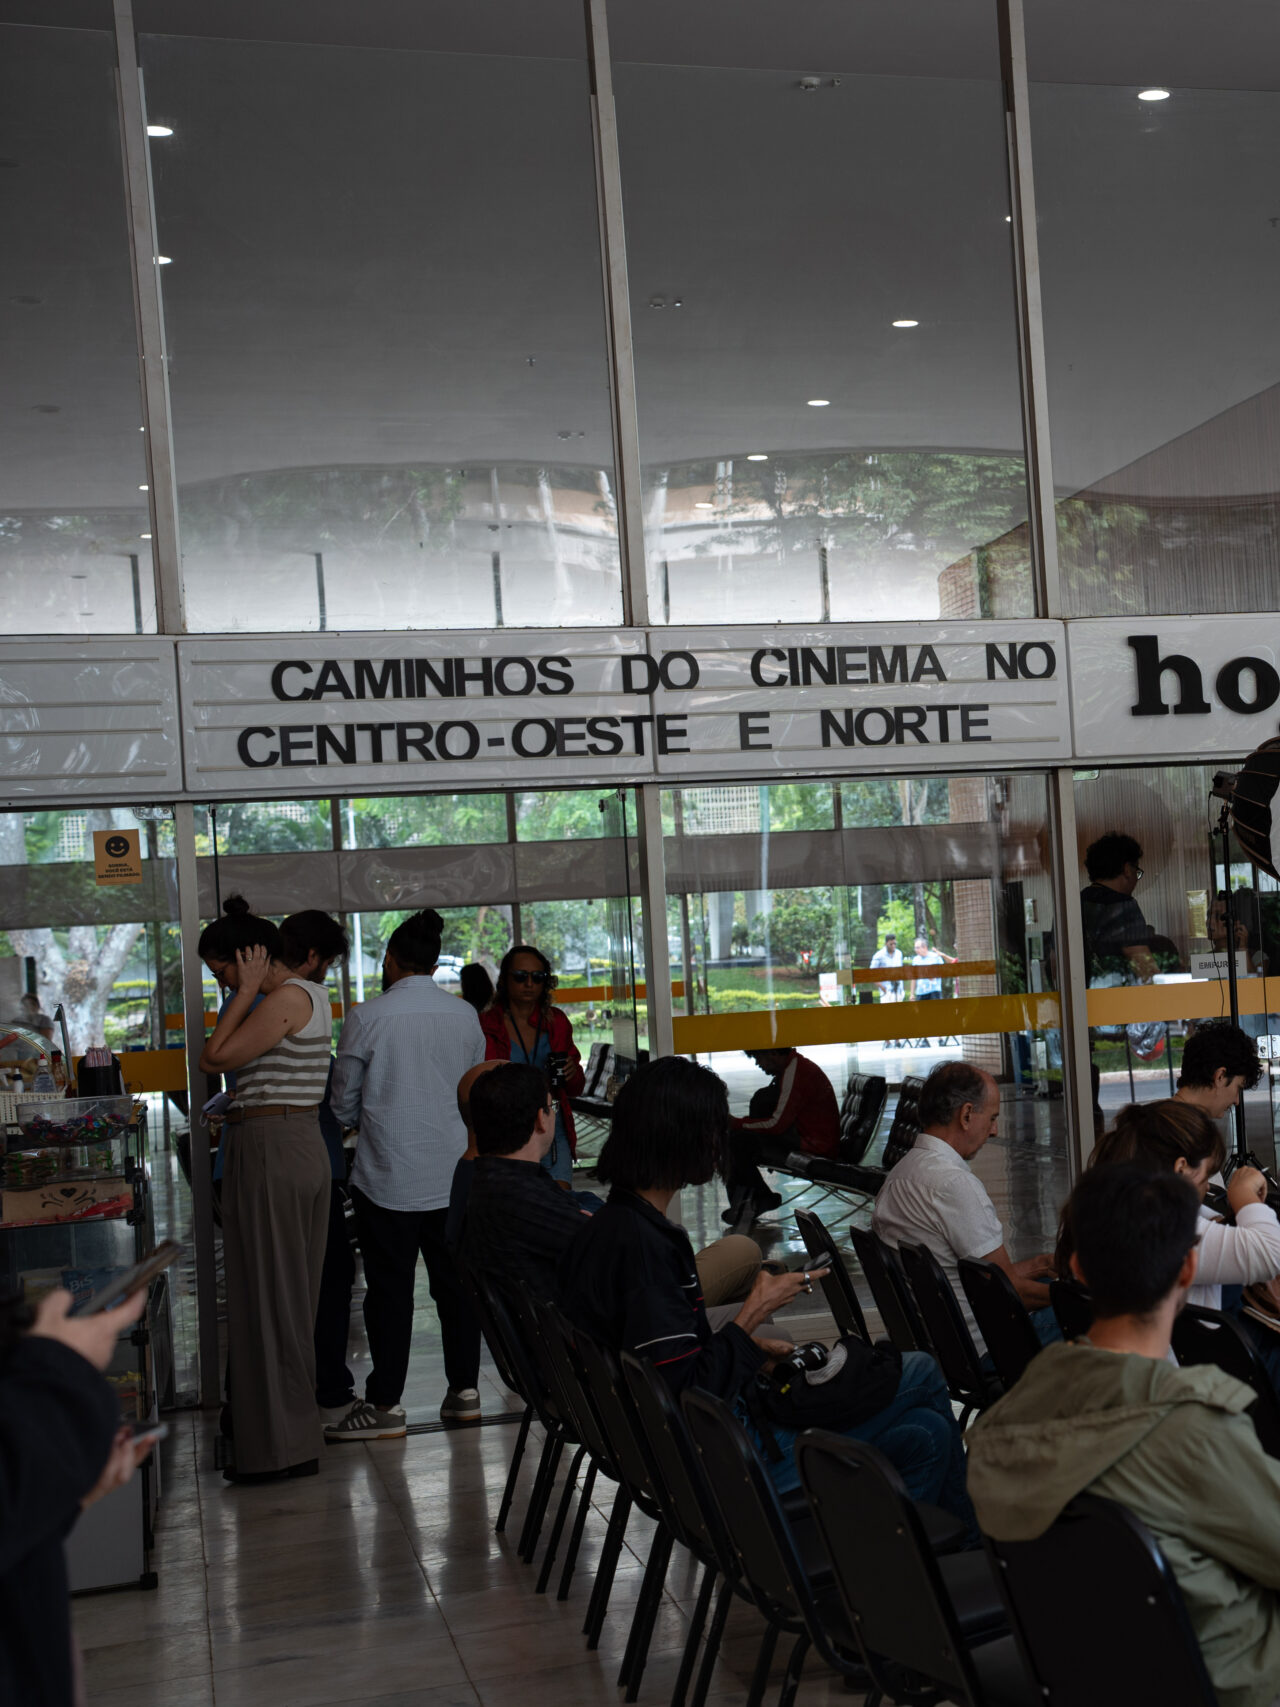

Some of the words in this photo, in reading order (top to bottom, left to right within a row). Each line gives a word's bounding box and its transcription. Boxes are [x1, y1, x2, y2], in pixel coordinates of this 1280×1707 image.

[270, 656, 575, 702] CAMINHOS
[621, 649, 700, 696] DO
[750, 645, 948, 687] CINEMA
[985, 641, 1057, 680] NO
[738, 711, 773, 751] E
[820, 704, 992, 748] NORTE
